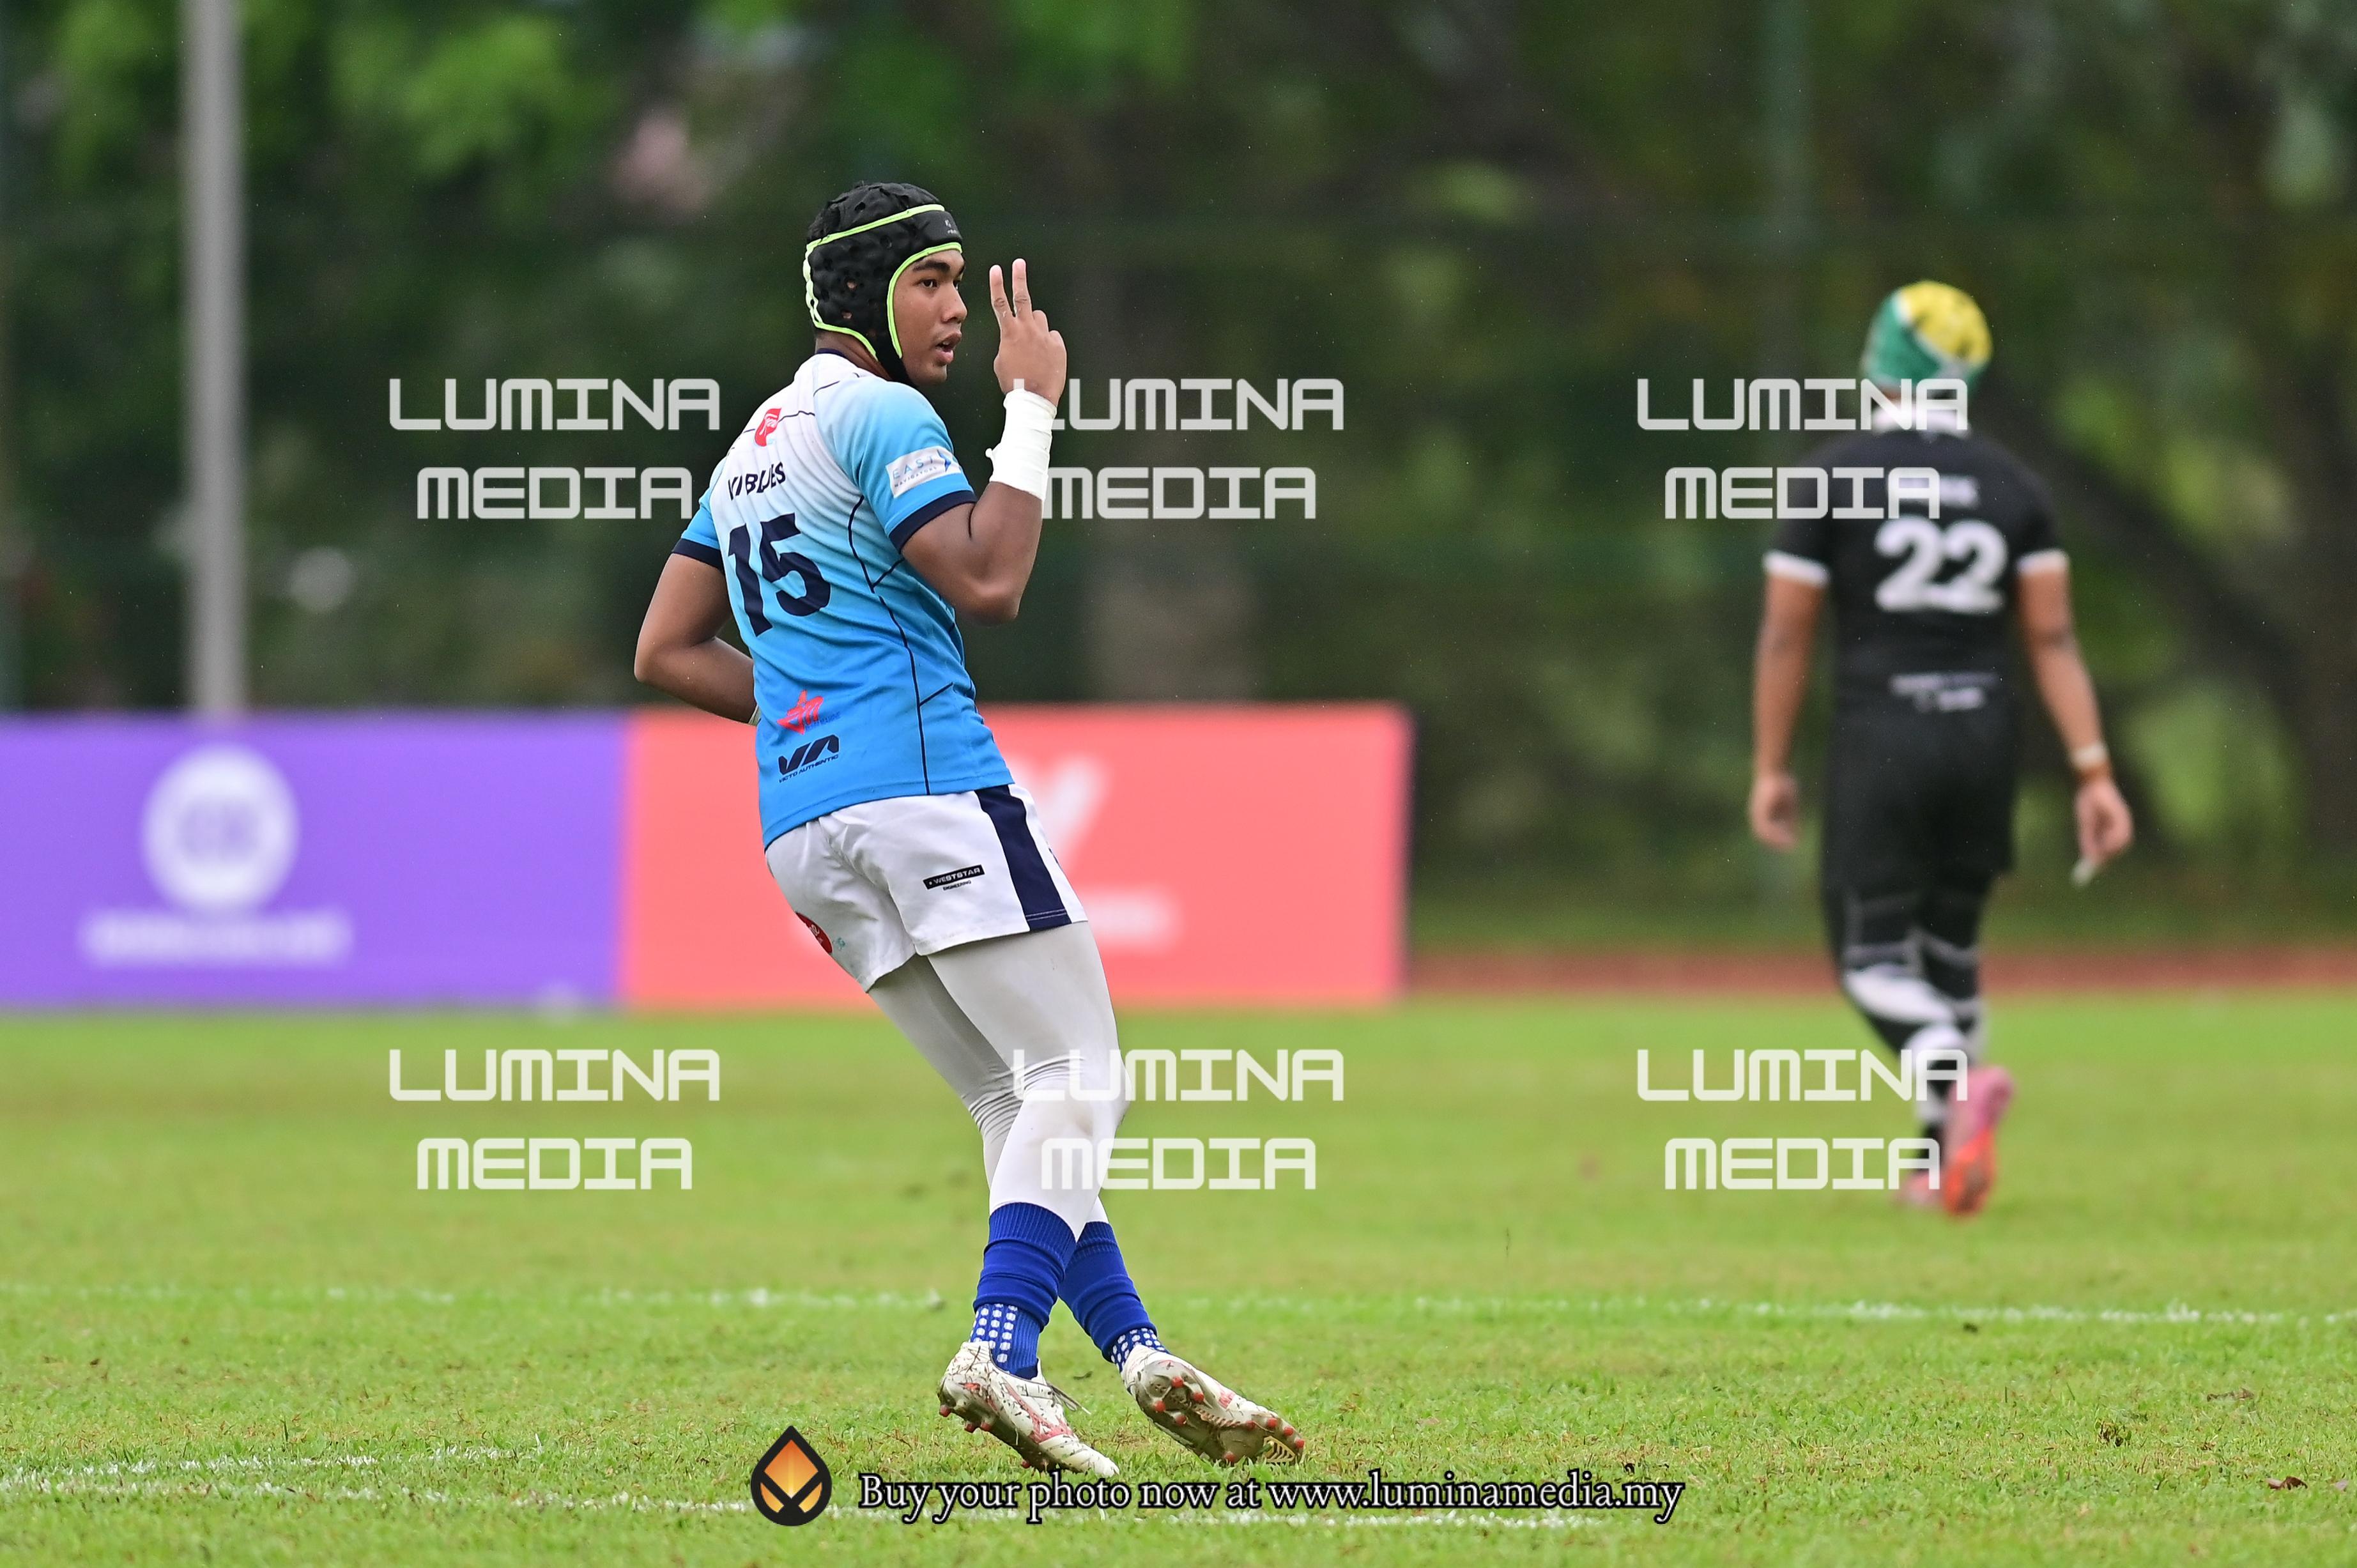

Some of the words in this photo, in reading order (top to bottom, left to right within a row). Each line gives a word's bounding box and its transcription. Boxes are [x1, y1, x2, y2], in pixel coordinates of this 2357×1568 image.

[727, 512, 831, 636] 15
[1873, 516, 2008, 615] 22
[933, 867, 981, 884] WESTSTAR
